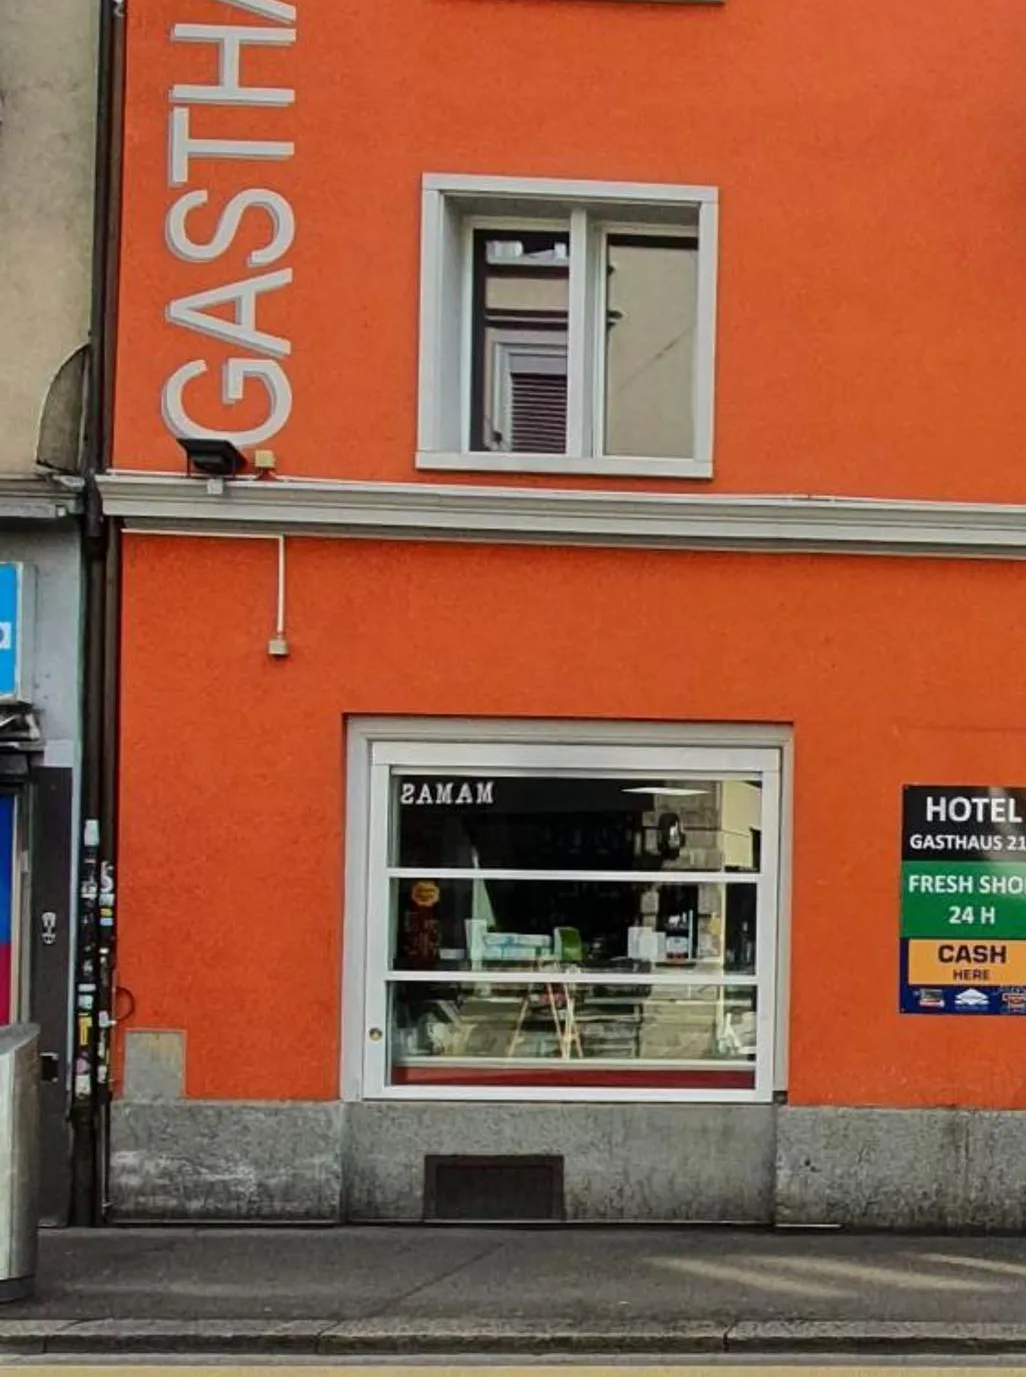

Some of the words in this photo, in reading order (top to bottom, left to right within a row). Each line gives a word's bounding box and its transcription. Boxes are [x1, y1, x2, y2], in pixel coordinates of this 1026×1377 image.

[926, 796, 1023, 823] HOTEL
[909, 833, 1002, 851] GASTHAUS
[908, 875, 974, 894] FRESH
[948, 906, 974, 924] 24
[981, 906, 996, 925] H
[938, 945, 1007, 964] CASH
[953, 969, 991, 981] HERE
